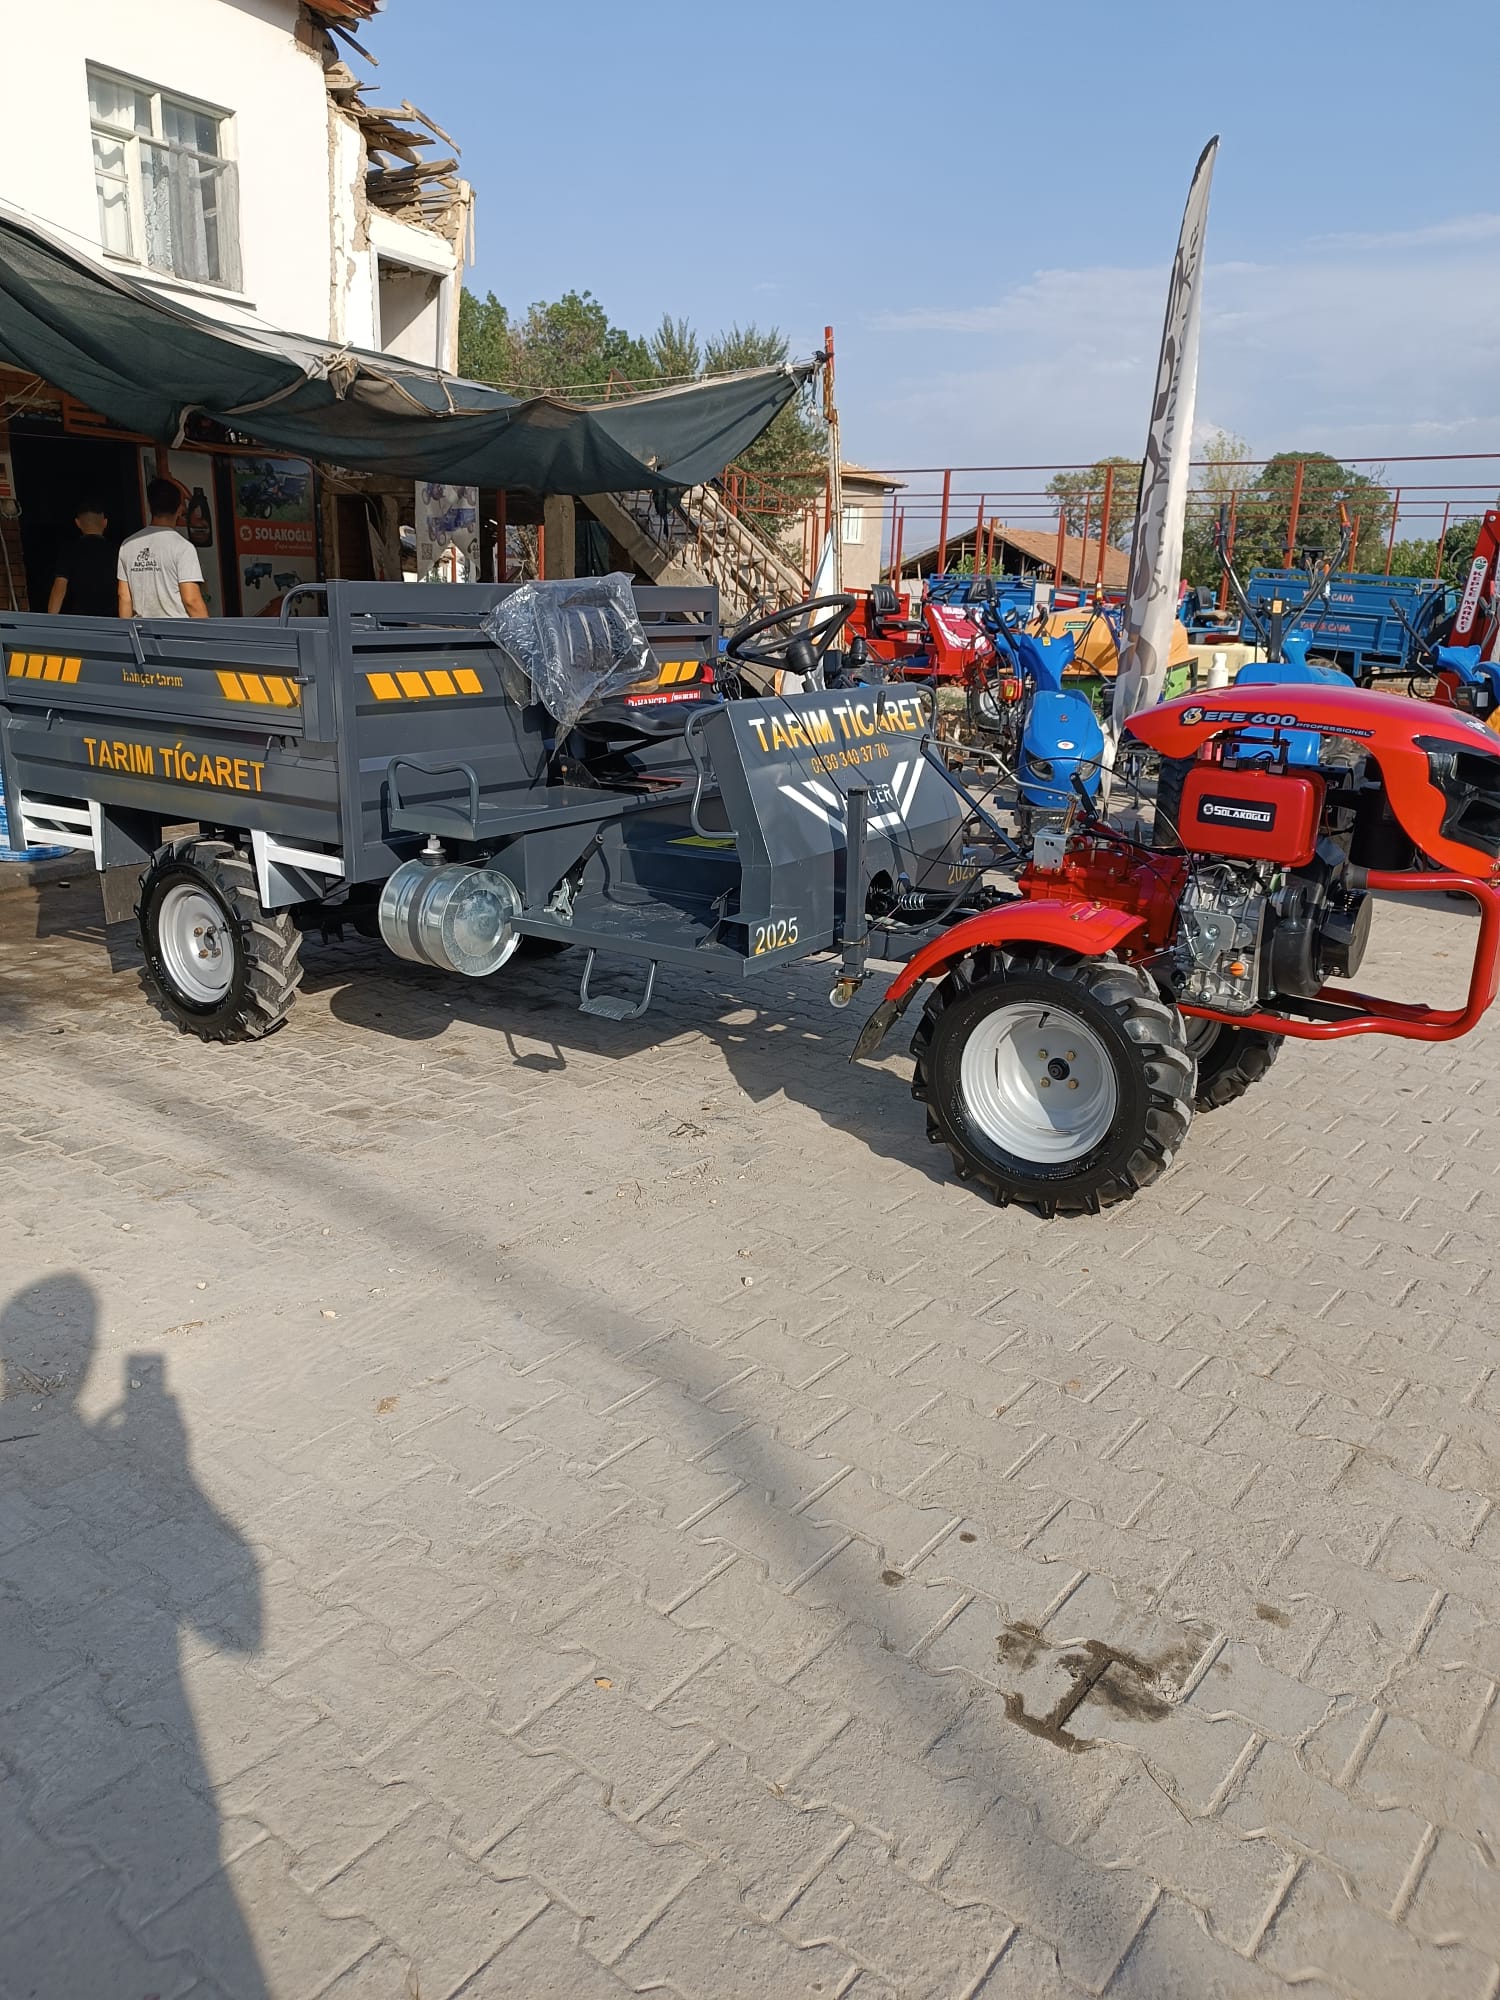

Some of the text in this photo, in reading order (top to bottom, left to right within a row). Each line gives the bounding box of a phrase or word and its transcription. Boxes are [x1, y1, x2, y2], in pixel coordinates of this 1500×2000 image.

[748, 709, 836, 752] TARIM
[1204, 711, 1247, 722] EFE
[1251, 713, 1296, 726] 600
[83, 737, 155, 776] TARIM
[839, 748, 860, 767] 340
[860, 745, 873, 762] 37
[874, 743, 889, 759] 78
[947, 855, 977, 885] 2025
[754, 916, 799, 955] 2025
